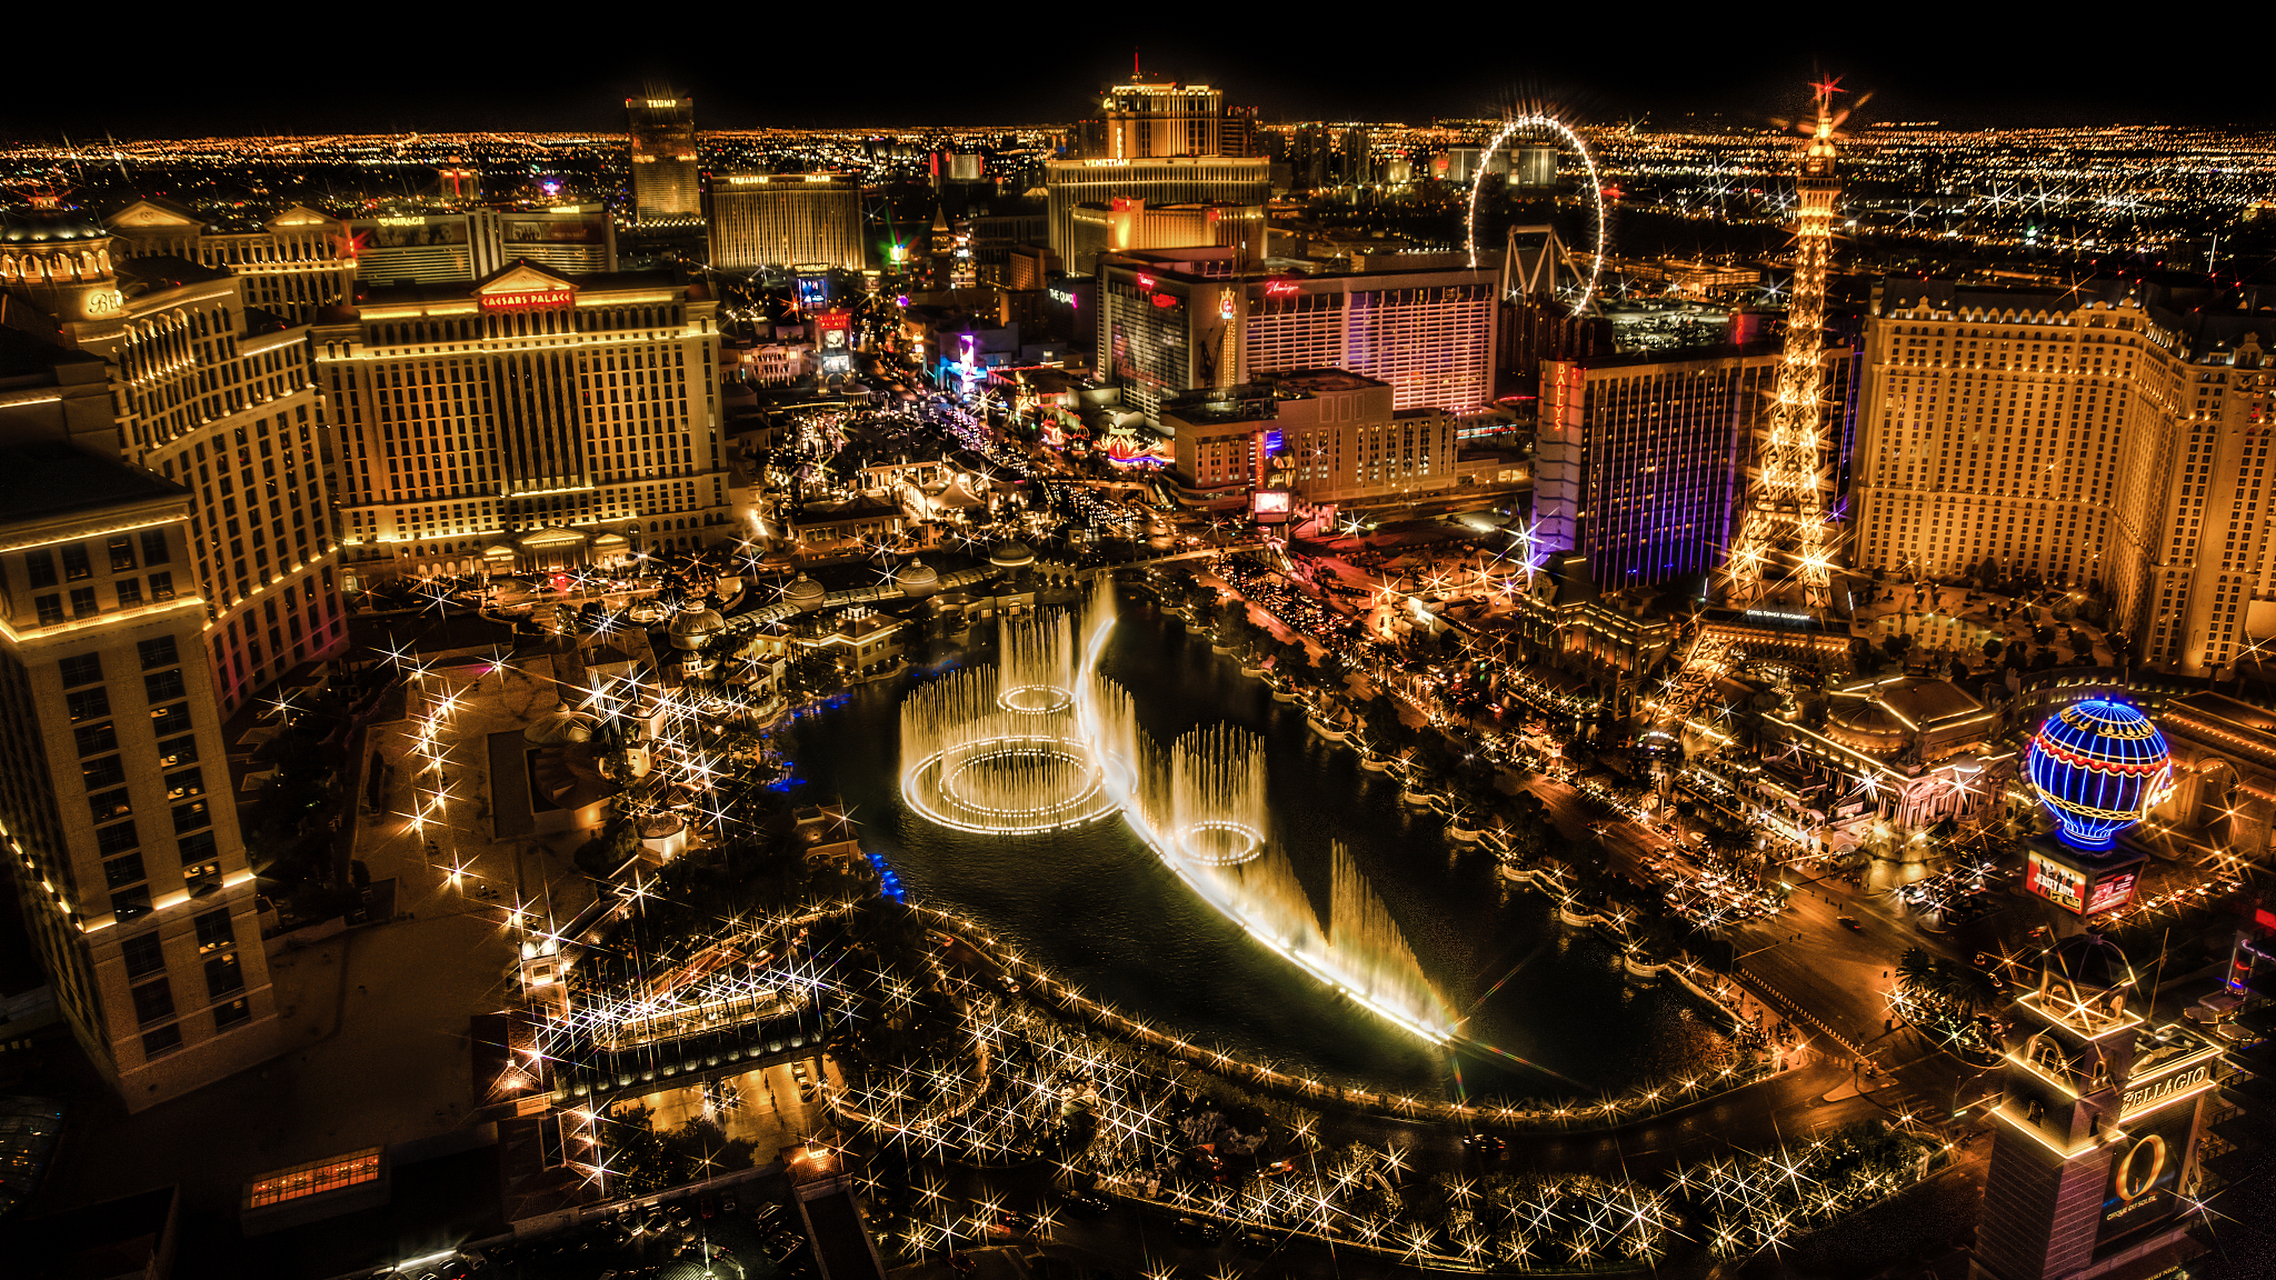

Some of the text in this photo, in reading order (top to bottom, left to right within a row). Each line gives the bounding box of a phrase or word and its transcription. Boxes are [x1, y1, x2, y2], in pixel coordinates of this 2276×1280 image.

[647, 99, 677, 108] TRUMP
[1084, 158, 1130, 167] VENETIAN
[729, 176, 769, 184] TREASURE
[389, 216, 426, 227] MIRAGE
[481, 292, 571, 307] CAESARS PALACE
[1049, 288, 1060, 301] THE
[1555, 363, 1566, 430] BALLYS
[1256, 434, 1264, 484] BALLYS
[2121, 1066, 2207, 1112] BELLAGIO
[2116, 1134, 2166, 1201] O
